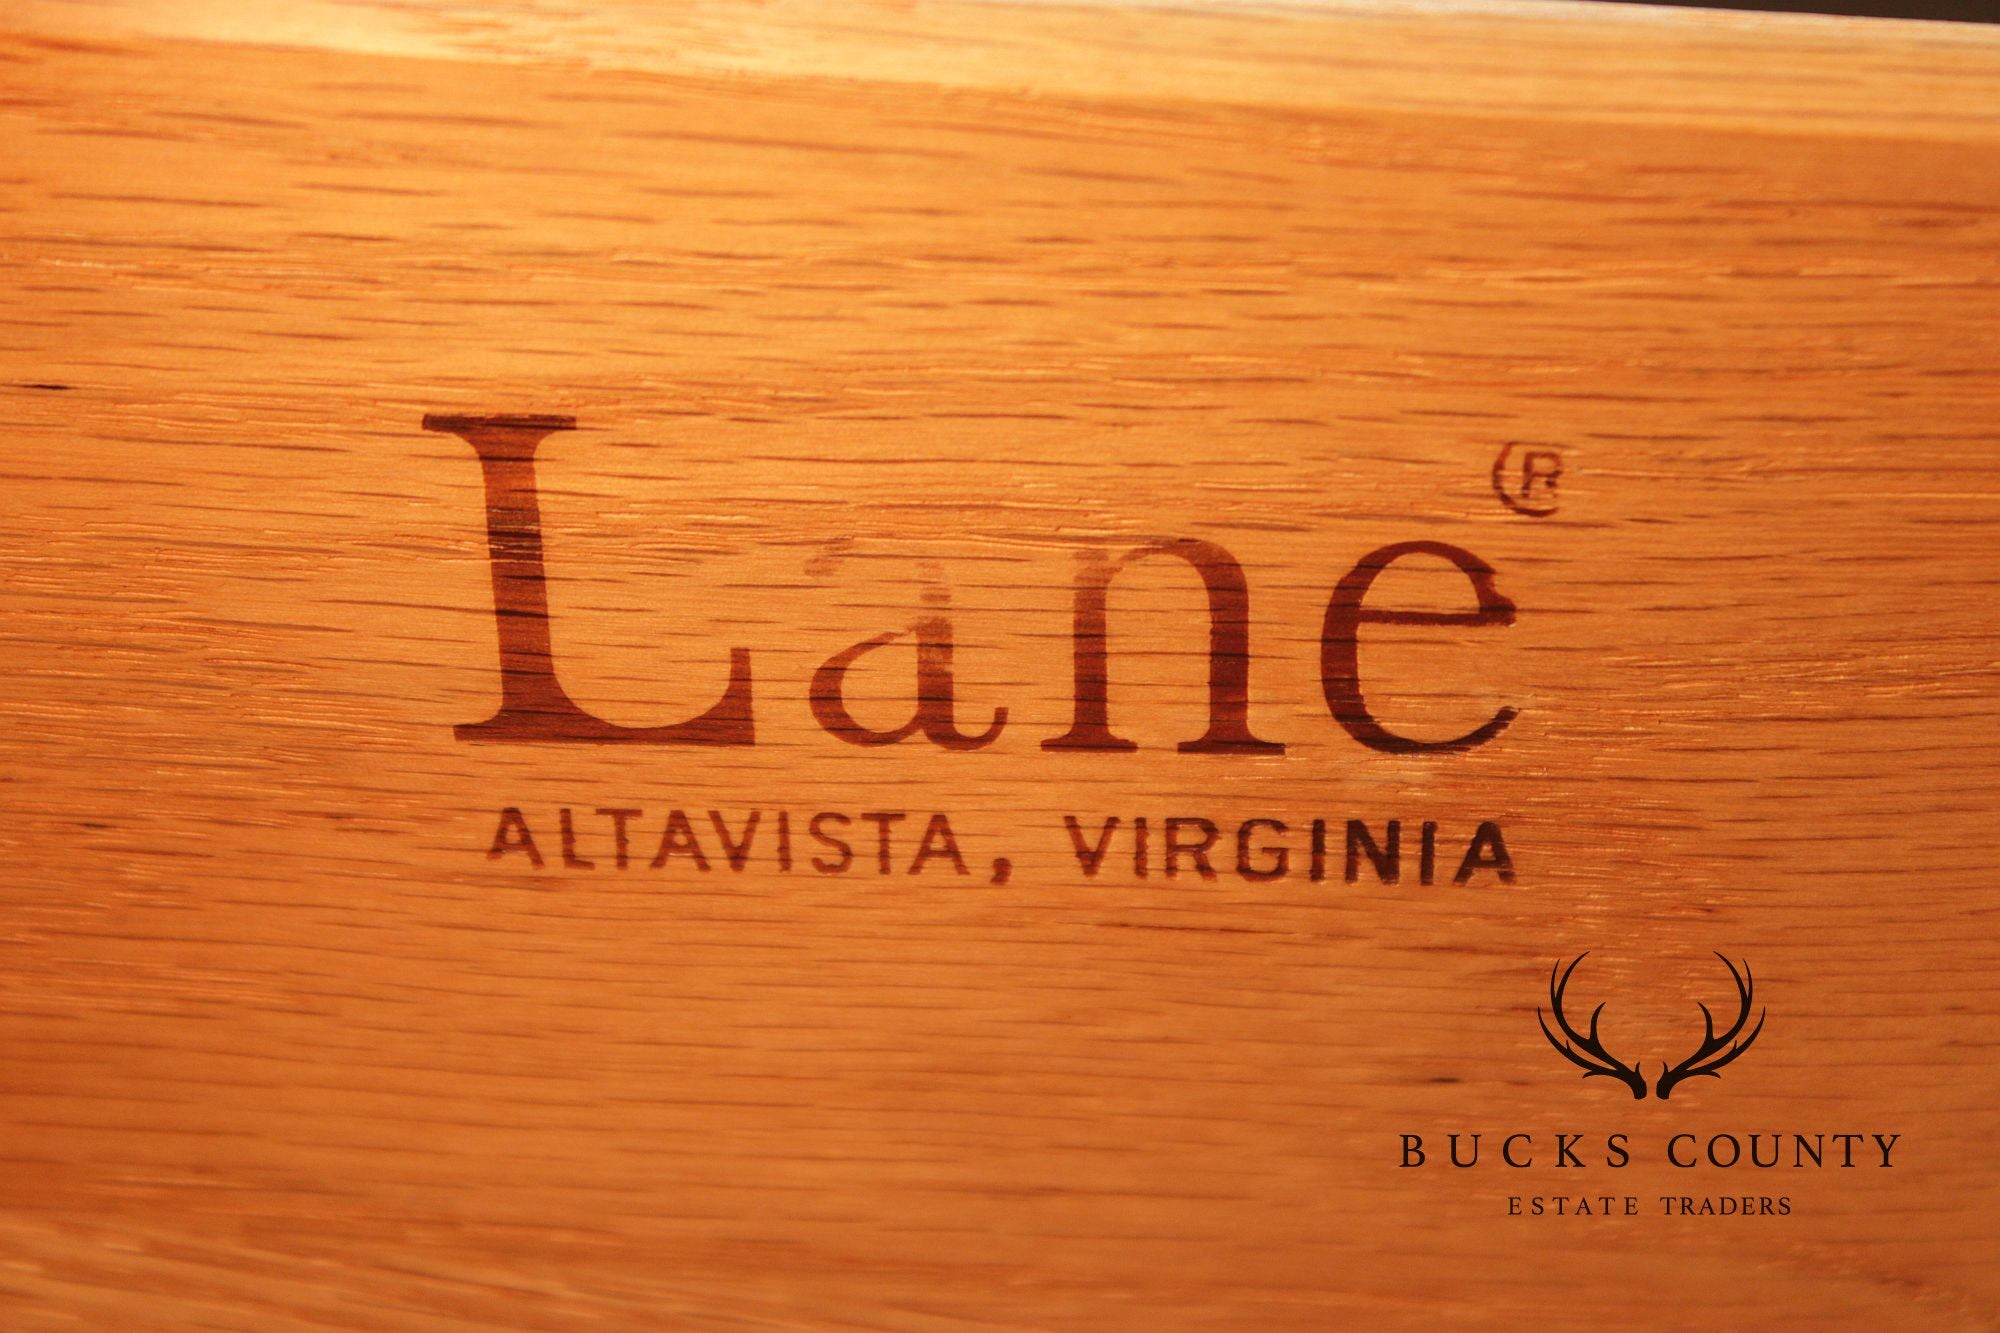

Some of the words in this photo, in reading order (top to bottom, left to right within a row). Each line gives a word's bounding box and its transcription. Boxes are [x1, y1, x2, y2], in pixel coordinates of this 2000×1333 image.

[423, 413, 1519, 754] Lane
[488, 805, 1011, 885] ALTAVISTA,
[1065, 816, 1515, 885] VIRGINIA
